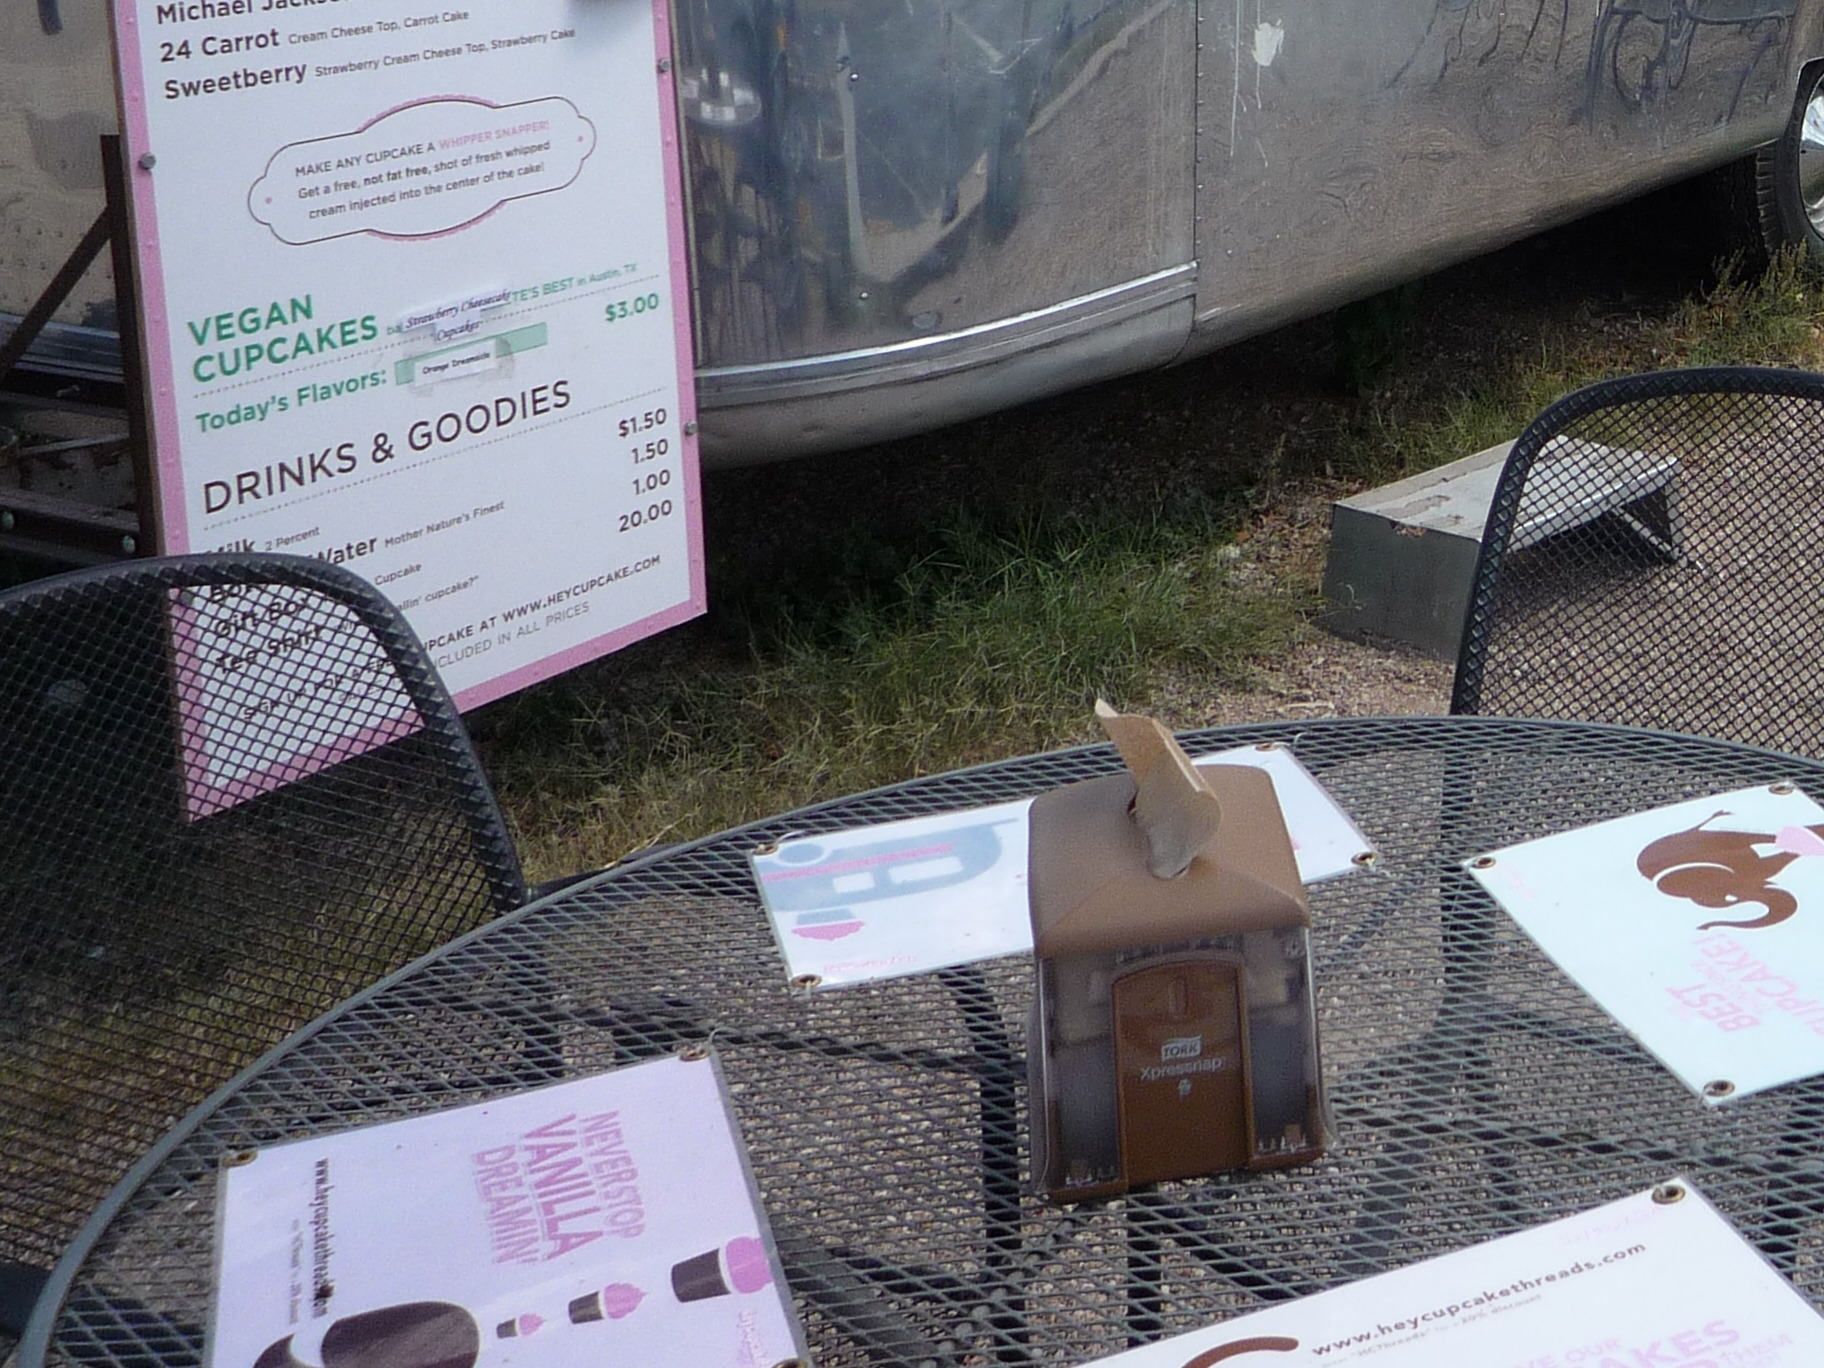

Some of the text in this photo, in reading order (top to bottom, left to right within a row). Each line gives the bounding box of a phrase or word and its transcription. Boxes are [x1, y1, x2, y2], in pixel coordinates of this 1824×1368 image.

[160, 9, 469, 63] 24 Carrot Cream Cheese Carrot Cake
[164, 28, 576, 100] Sweetberry Strawberry Cream Cheese Strawberry Cake
[295, 119, 550, 177] MAKE ANY CUPCAKE A WHIPPER SNAPPER!
[298, 139, 551, 200] Get a free, not fat free, shot of fresh whipped
[309, 161, 544, 220] cream injected into the center of the cake!
[188, 294, 314, 346] VEGAN
[193, 276, 575, 383] CUPCAKES BEST
[405, 306, 458, 329] Strawberry
[605, 292, 660, 323] $3.00
[195, 394, 289, 433] Today's
[297, 369, 387, 407] Flavors:
[204, 380, 571, 514] DRINKS & GOODIES
[264, 408, 668, 551] 2 Percent $1.50
[384, 528, 423, 548] Mother
[426, 512, 470, 534] Nature's
[473, 500, 505, 519] Finest
[631, 438, 669, 465] 1.50
[374, 468, 671, 587] Cupcake 1.00
[618, 499, 672, 533] 20.00
[479, 554, 661, 632] AT WWW.HEYCUPCAKE.COM
[498, 600, 590, 646] IN ALL PRICES
[1664, 984, 1761, 1033] BEST
[1163, 1042, 1198, 1058] TORK
[472, 1143, 539, 1264] DREAMIN'
[523, 1113, 604, 1261] VANILLA
[580, 1109, 645, 1240] NEVER STOP
[1312, 1241, 1646, 1356] www.heycupcakethreads.com
